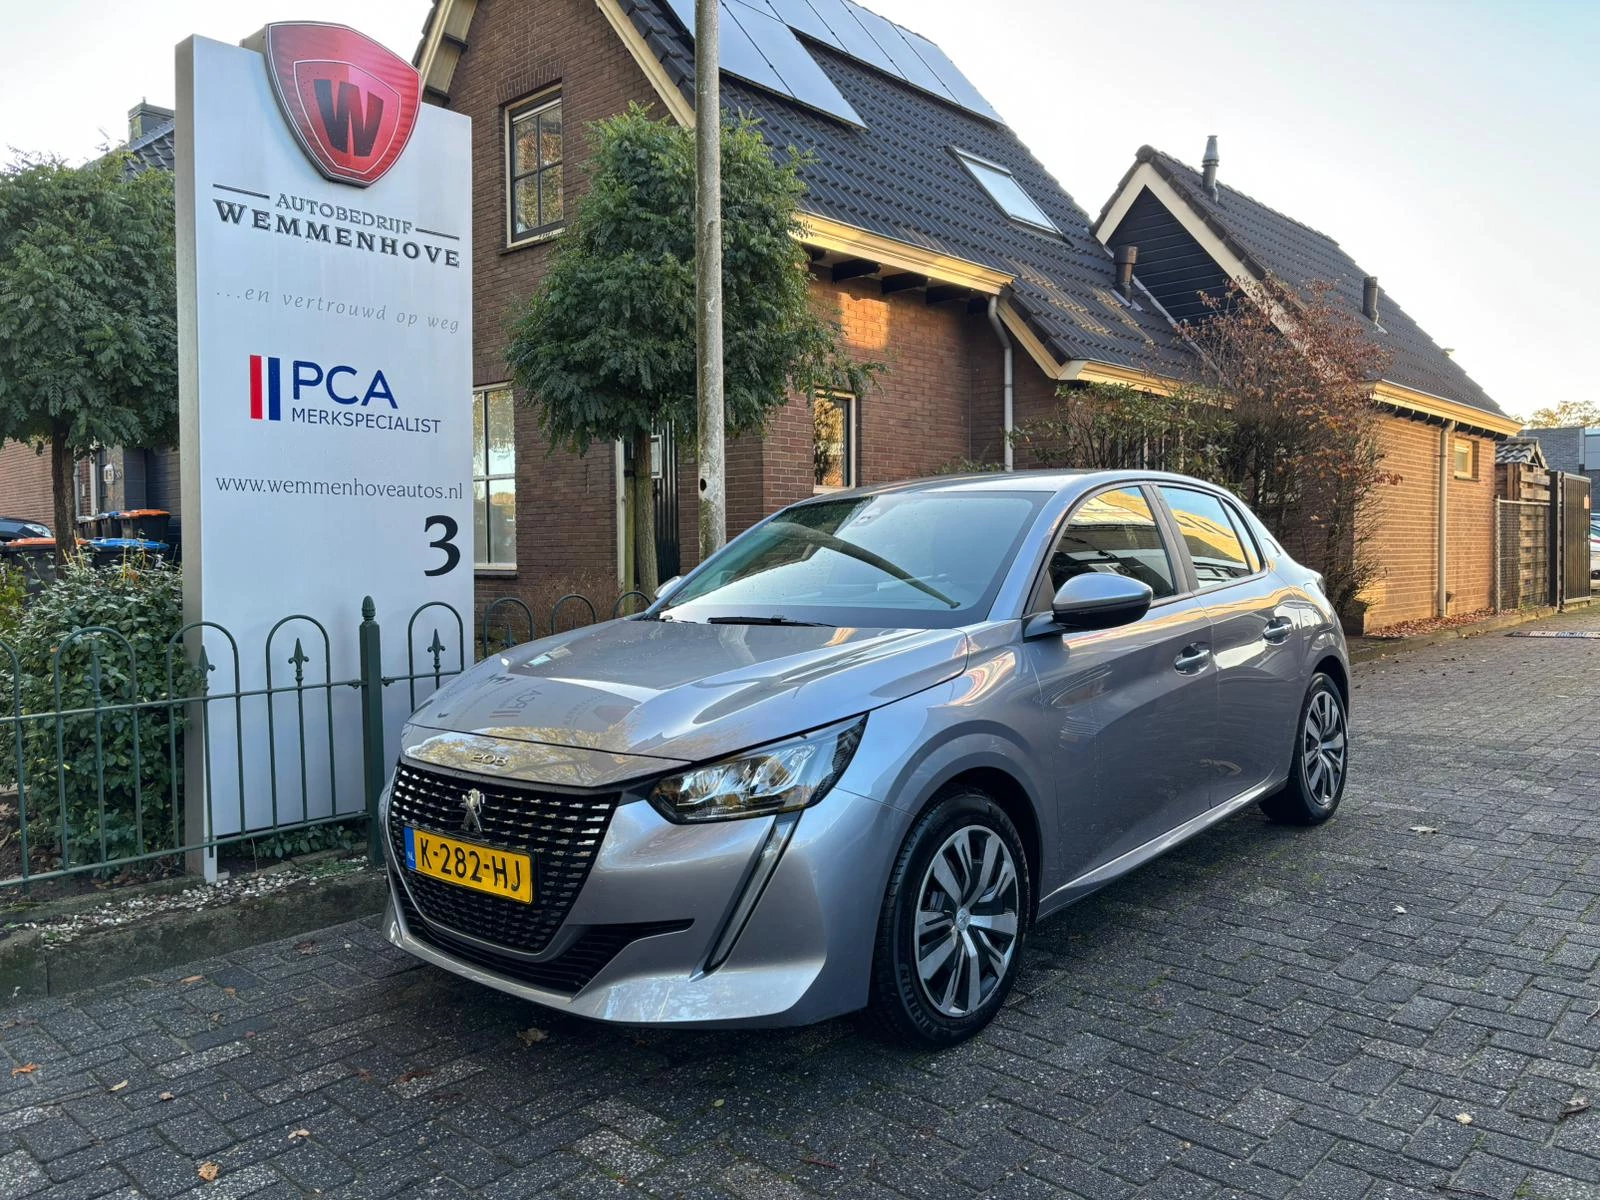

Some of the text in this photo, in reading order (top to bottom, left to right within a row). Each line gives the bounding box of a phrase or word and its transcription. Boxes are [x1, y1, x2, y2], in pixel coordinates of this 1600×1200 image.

[313, 79, 384, 157] W
[212, 199, 460, 267] WEMMENHOVE
[275, 193, 413, 234] AUTOBEDRIJF
[283, 292, 387, 321] vertrouwd
[396, 312, 418, 328] op
[427, 315, 460, 334] weg
[292, 360, 399, 410] PCA
[292, 408, 441, 434] MERKSPECIALIST
[215, 477, 463, 500] www.wemmenhoveautos.nl
[424, 514, 461, 577] 3
[471, 752, 508, 767] 208
[420, 837, 521, 892] K-282-HJ
